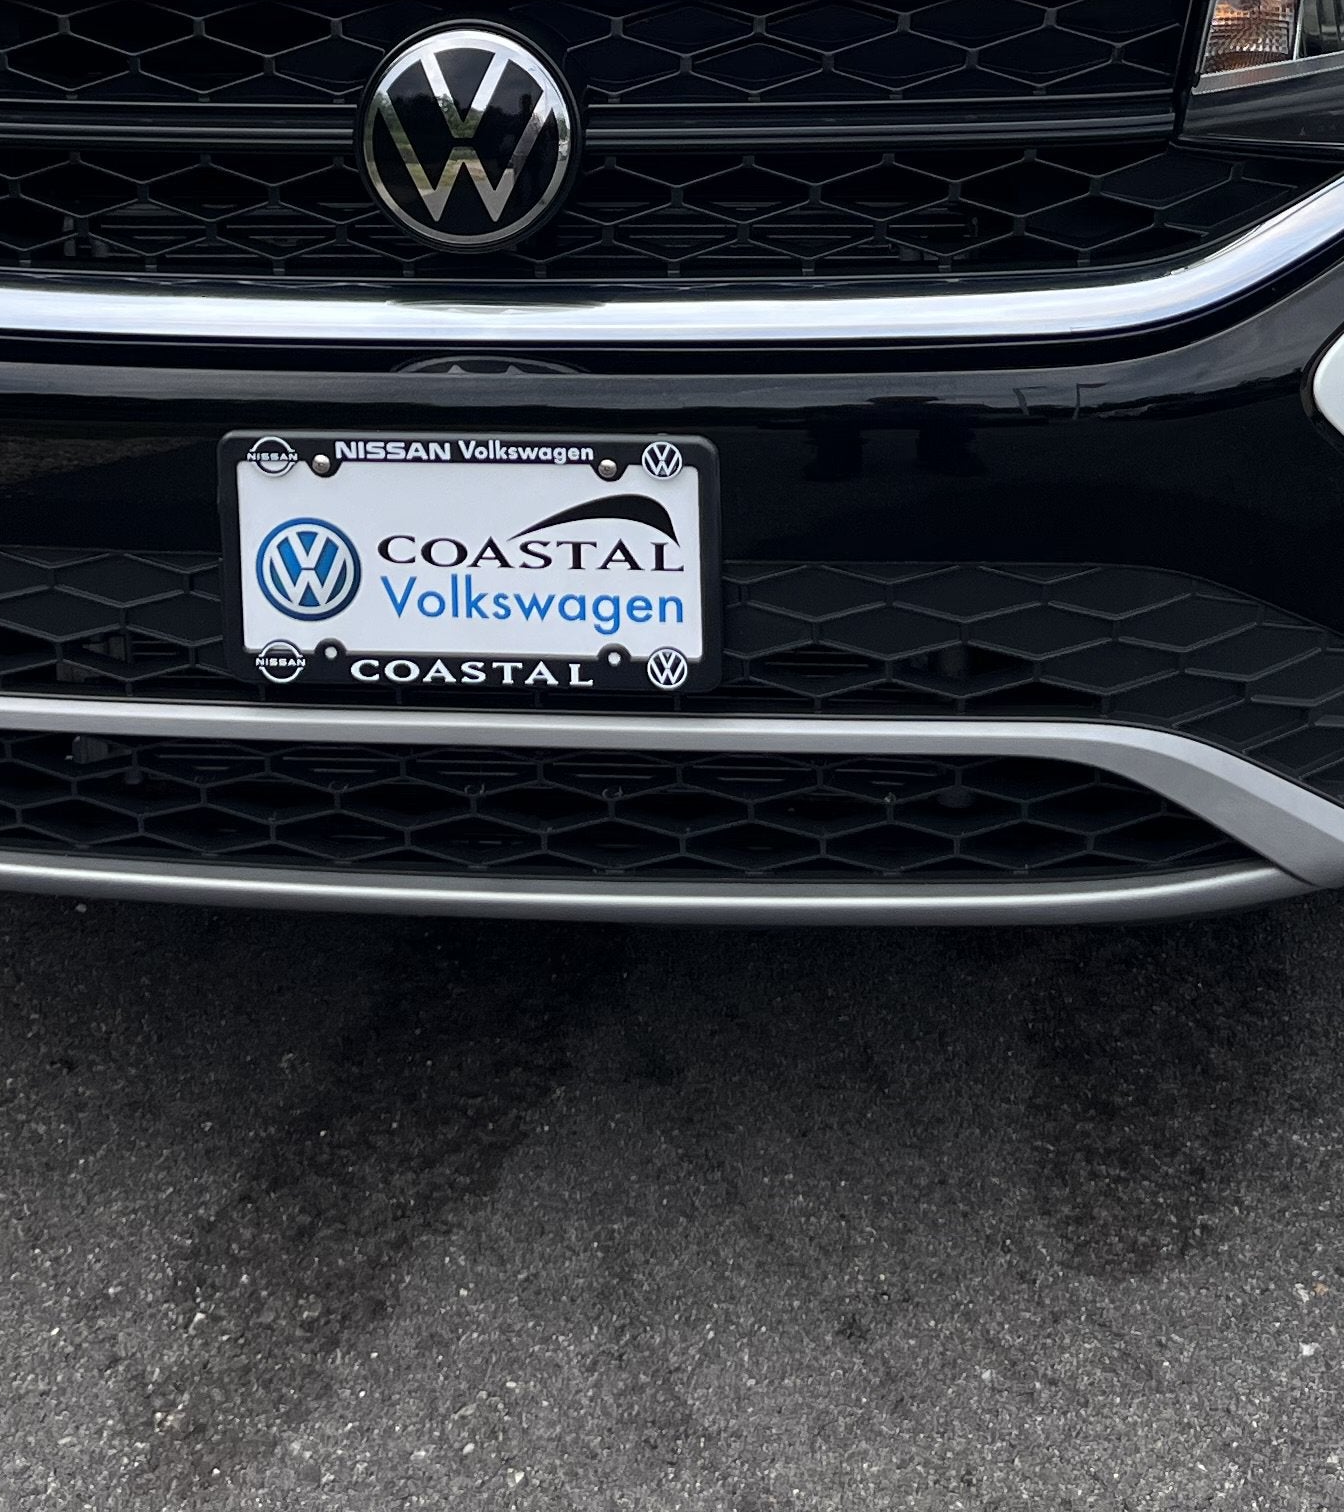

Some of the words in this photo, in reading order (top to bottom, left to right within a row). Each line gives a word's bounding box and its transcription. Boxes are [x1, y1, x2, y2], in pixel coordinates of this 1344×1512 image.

[363, 29, 571, 245] VW
[246, 452, 298, 461] NISSAN
[335, 441, 451, 460] NISSAN
[458, 440, 594, 464] Volkswagen
[642, 441, 683, 480] VW
[256, 517, 361, 622] VW
[377, 534, 685, 572] COASTAL
[380, 573, 684, 635] Volkswagen
[256, 658, 306, 667] NISSAN
[350, 659, 594, 687] COASTAL
[647, 648, 688, 688] VW
